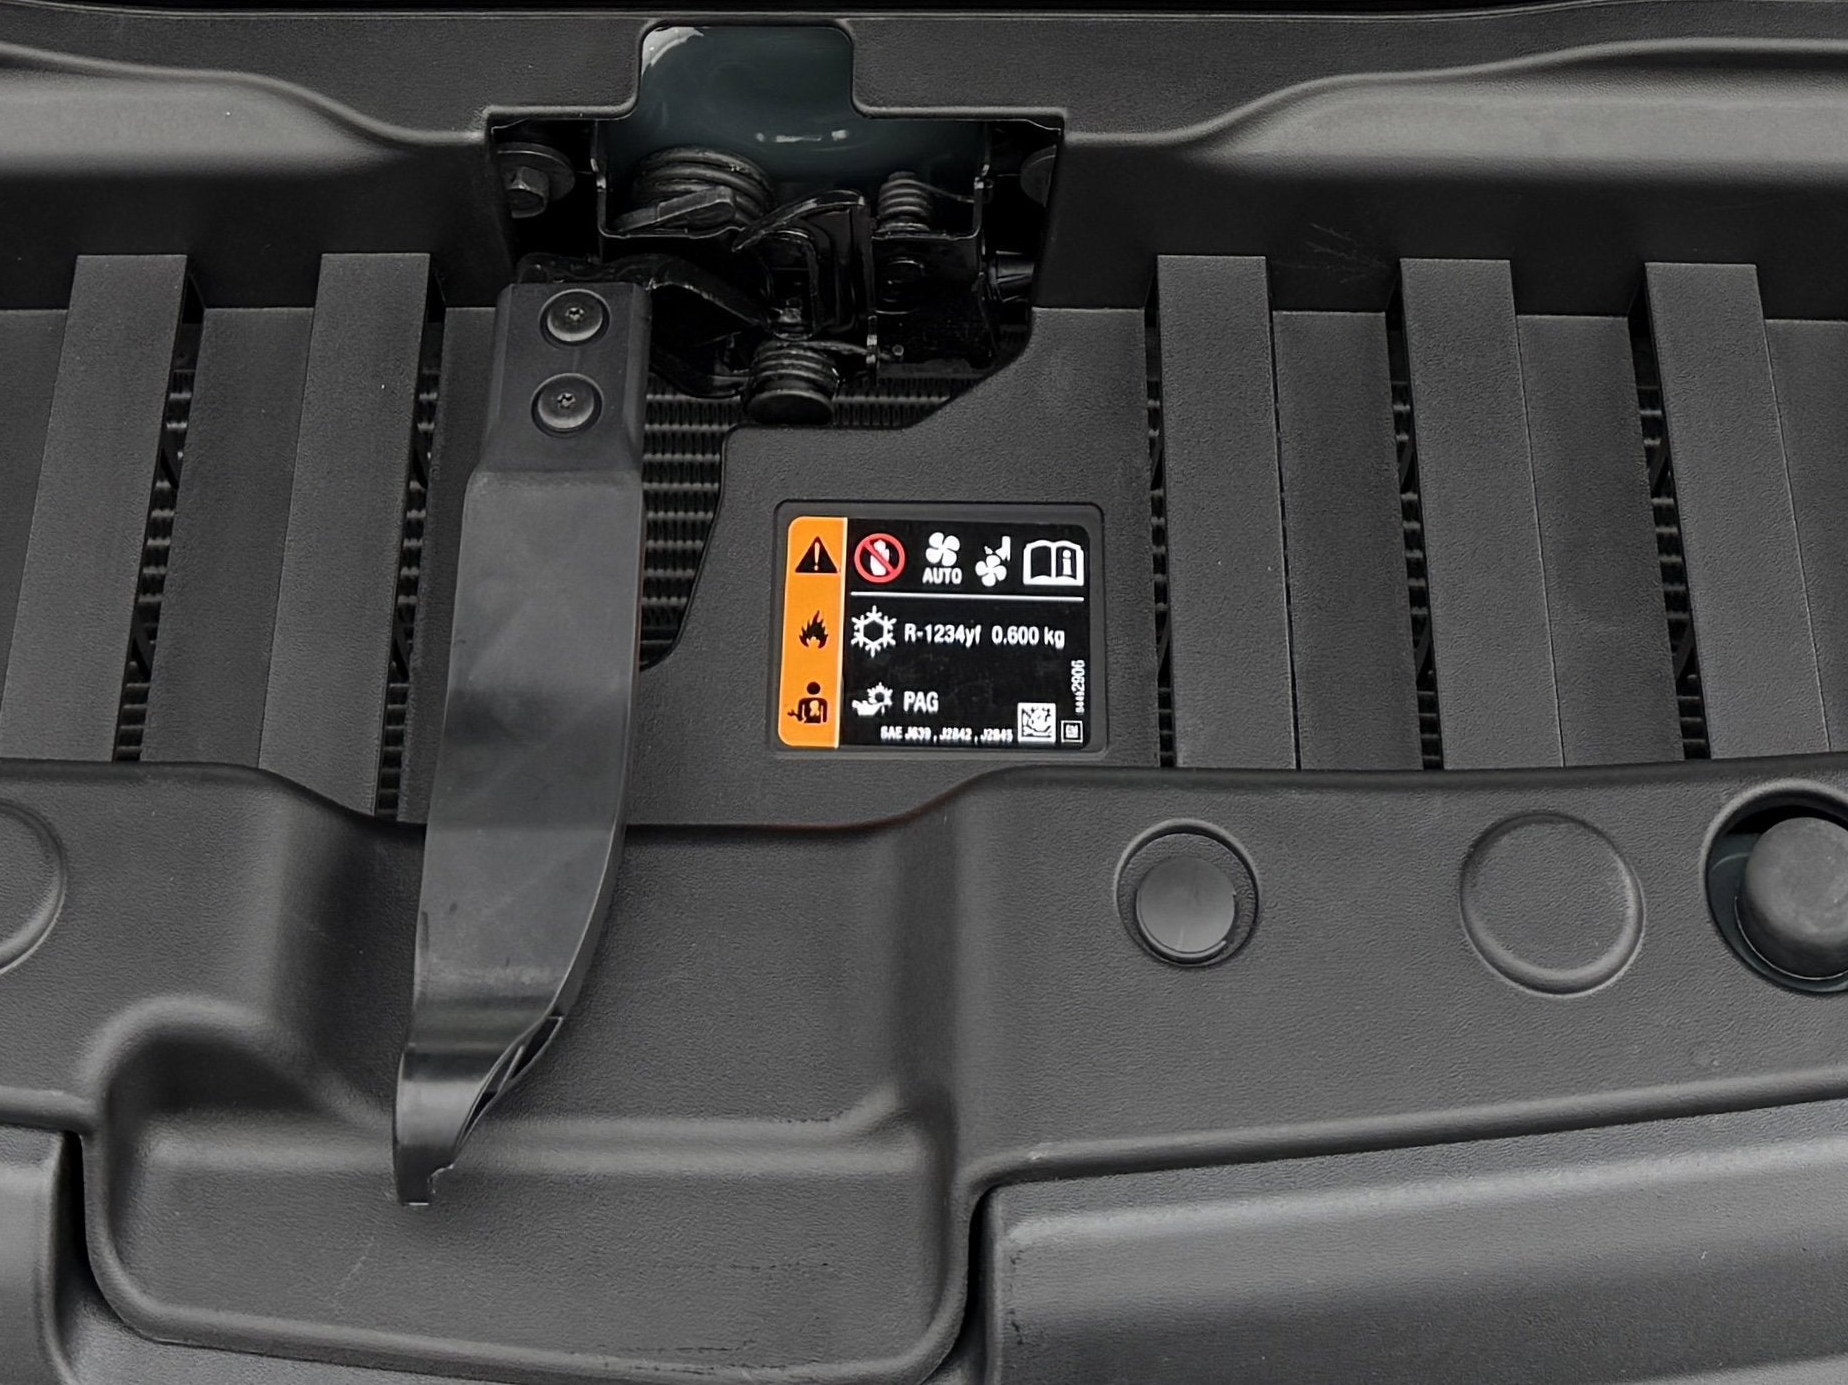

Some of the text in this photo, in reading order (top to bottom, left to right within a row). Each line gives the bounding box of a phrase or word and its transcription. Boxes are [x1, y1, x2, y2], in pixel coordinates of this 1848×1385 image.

[922, 567, 963, 585] AUTO
[904, 623, 1066, 650] R-1234yf 0.600 kg
[903, 691, 940, 714] PAG
[880, 725, 903, 740] SAE
